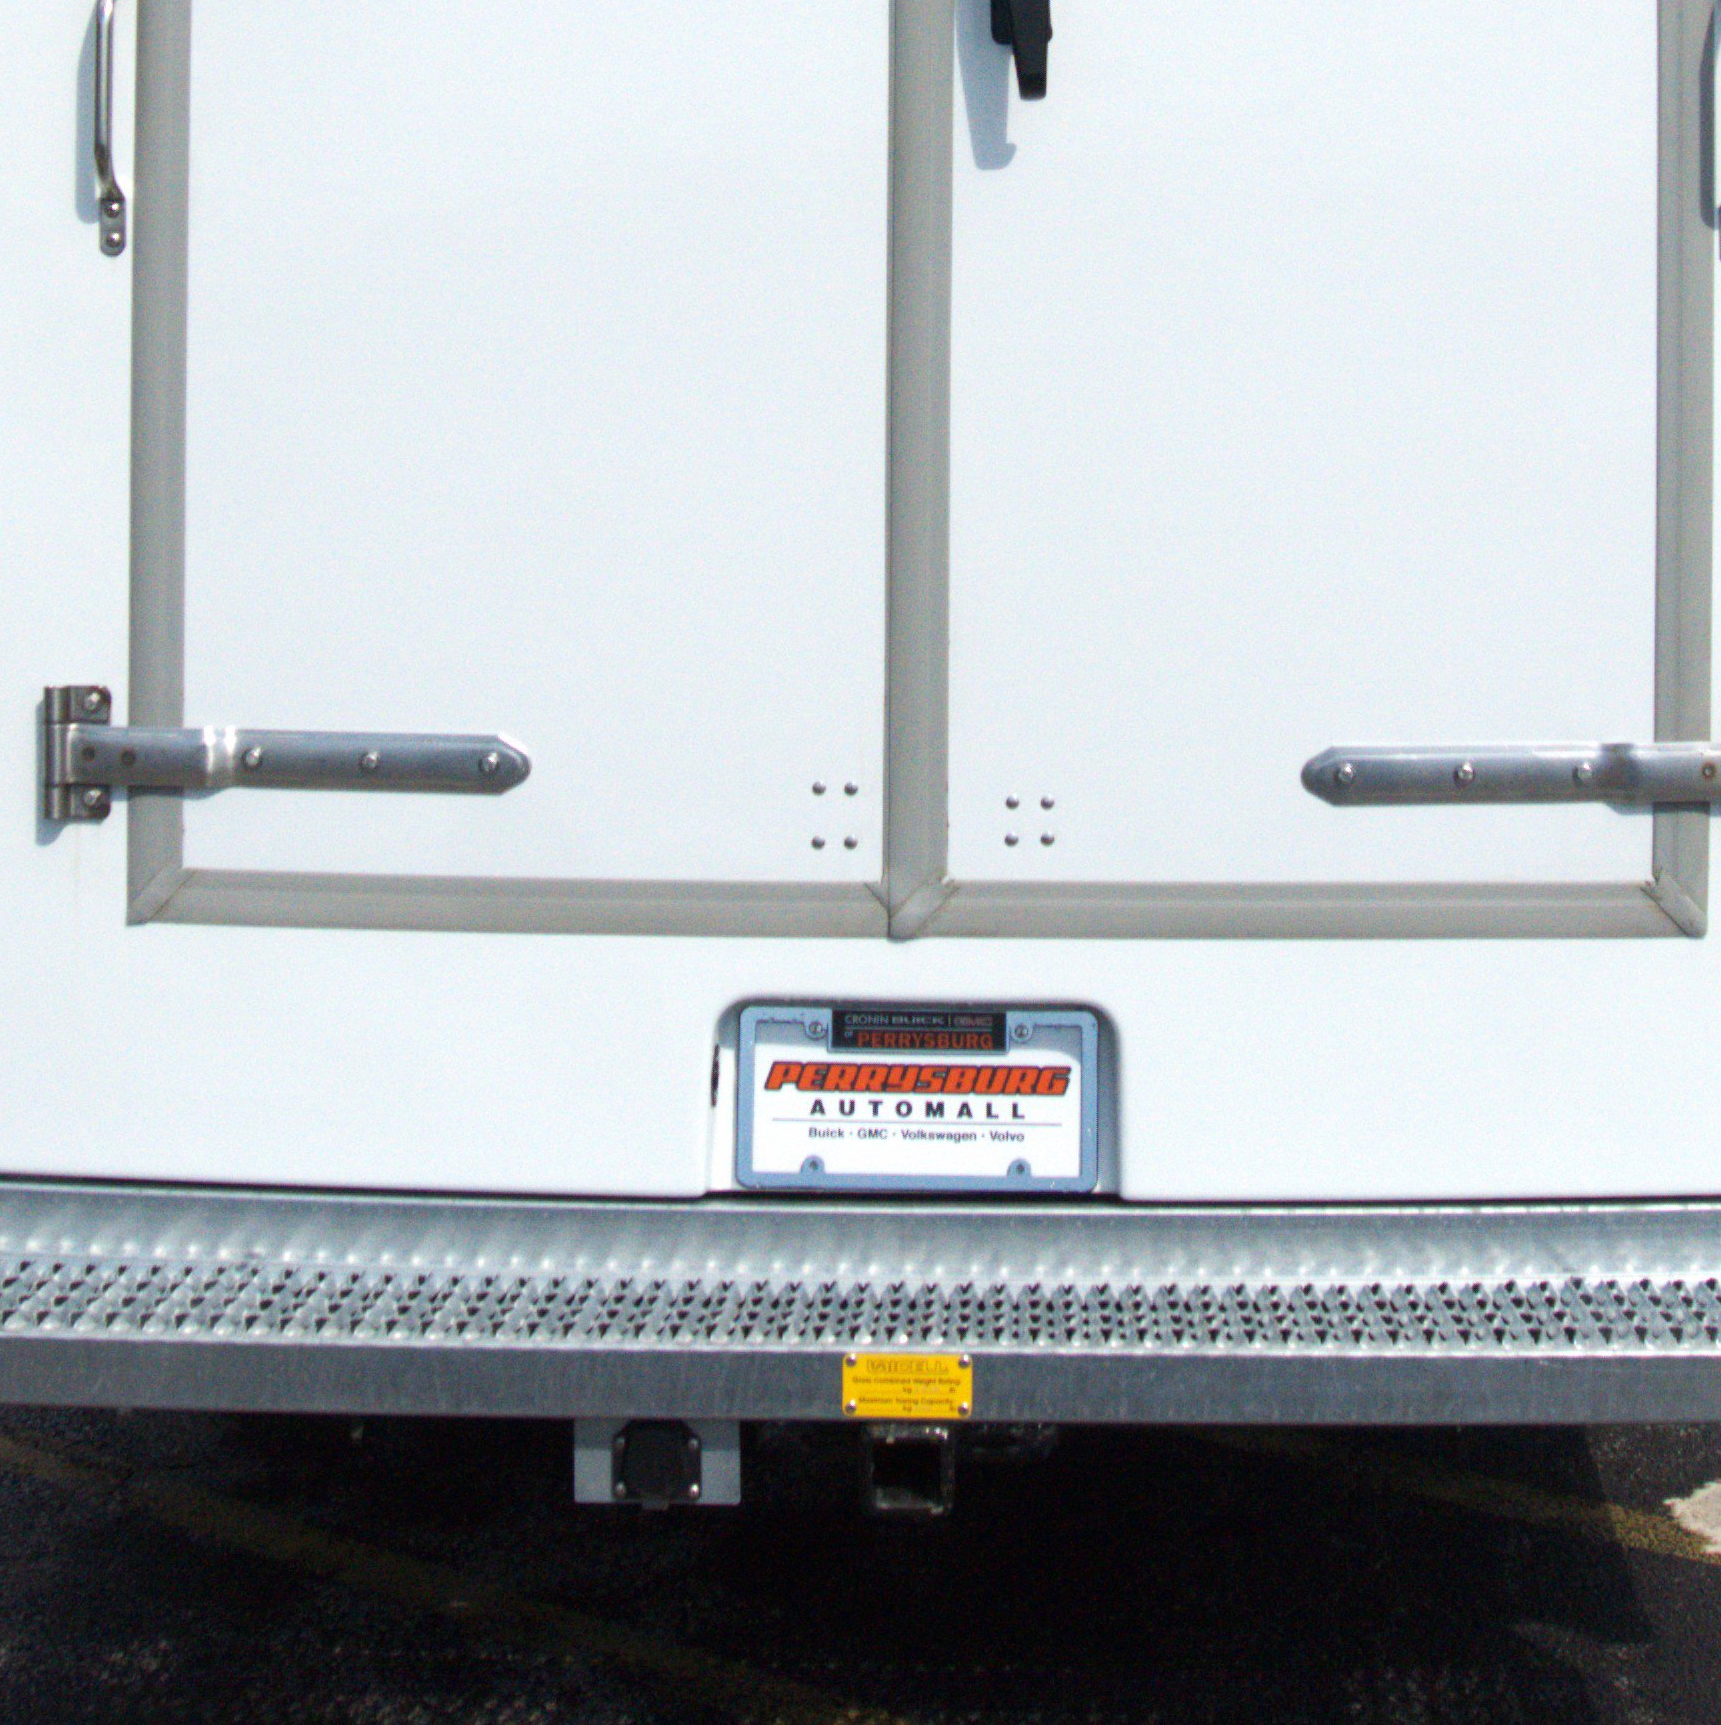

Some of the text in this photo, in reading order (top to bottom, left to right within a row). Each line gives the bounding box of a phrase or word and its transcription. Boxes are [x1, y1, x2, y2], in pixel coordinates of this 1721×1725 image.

[857, 1032, 994, 1049] PERRYSBURG
[764, 1060, 1072, 1096] PERRYSBURG
[810, 1099, 1025, 1119] AUTOMALL
[808, 1127, 1025, 1144] Buick GMC Volkswagen Volvo
